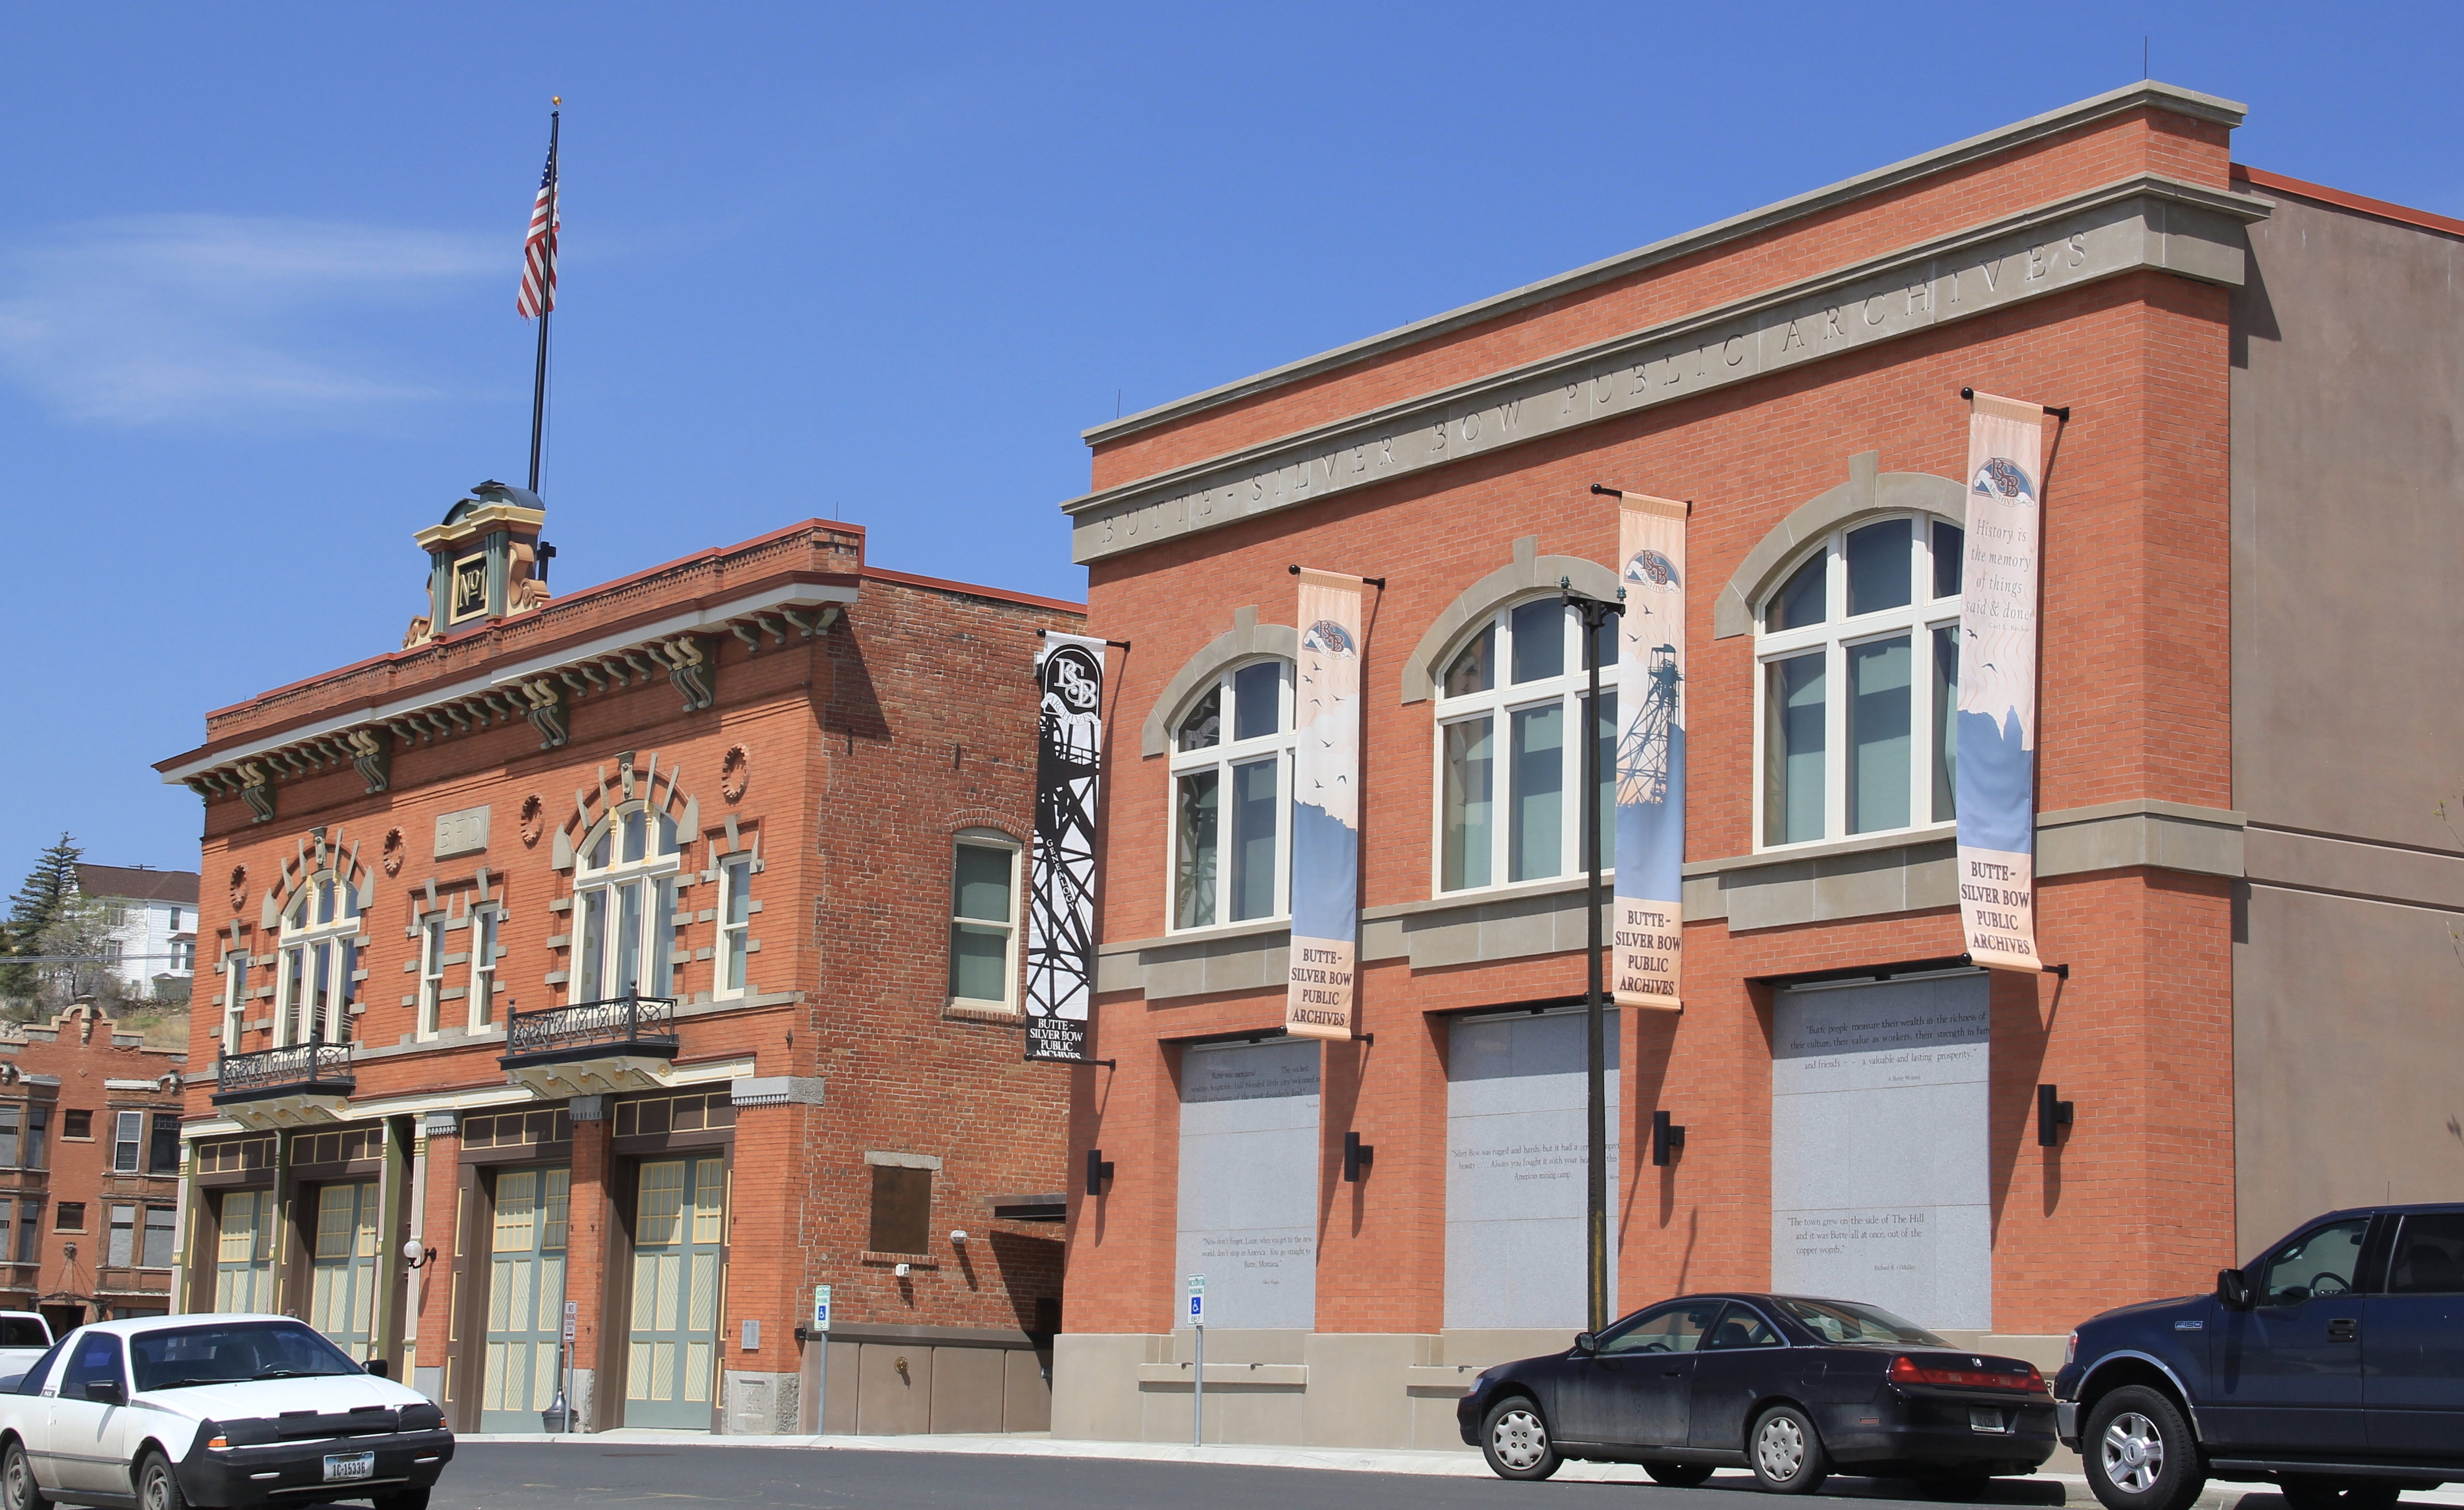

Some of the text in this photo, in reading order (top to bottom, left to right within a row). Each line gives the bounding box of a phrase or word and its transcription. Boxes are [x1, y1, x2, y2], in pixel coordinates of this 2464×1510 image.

[1431, 397, 1523, 452] BOW
[1563, 334, 1745, 414] PUBLIC
[1781, 230, 2085, 352] ARCHIVES
[1987, 484, 2021, 506] ARCHIVES
[1976, 519, 2027, 544] History is
[1971, 545, 2031, 572] the memory
[1976, 572, 2022, 597] of things
[1966, 599, 2032, 621] said & done.
[2010, 625, 2030, 633] Becker
[1048, 696, 1092, 723] ARCHIVES
[1046, 839, 1074, 910] GENEALOGY
[1961, 884, 2030, 908] SILVER BOW
[1976, 910, 2018, 930] PUBLIC
[1615, 931, 1681, 951] SILVER BOW
[1973, 931, 2030, 955] ARCHIVES
[1628, 955, 1669, 972] PUBLIC
[1292, 968, 1352, 986] SILVER BOW
[1620, 975, 1674, 995] ARCHIVES
[1302, 989, 1339, 1005] PUBLIC
[1293, 1007, 1345, 1025] ARCHIVES
[1829, 1022, 1848, 1035] people
[1851, 1022, 1880, 1031] measure
[1882, 1019, 1899, 1028] their
[1901, 1016, 1924, 1026] wealth
[1937, 1015, 1948, 1023] the
[1950, 1013, 1976, 1022] richness
[1979, 1010, 1986, 1020] of
[1030, 1028, 1083, 1041] SILVER BOW
[1791, 1041, 1805, 1049] their
[1807, 1039, 1831, 1048] culture,
[1834, 1037, 1848, 1046] their
[1851, 1035, 1869, 1044] value
[1882, 1032, 1911, 1042] workers,
[1916, 1031, 1933, 1039] their
[1937, 1028, 1965, 1039] strength
[1976, 1025, 1989, 1034] fam
[1041, 1040, 1073, 1051] PUBLIC
[1804, 1060, 1815, 1069] and
[1818, 1058, 1840, 1068] friends
[1869, 1054, 1894, 1065] valuable
[1896, 1053, 1908, 1062] and
[1911, 1053, 1932, 1062] lasting
[1493, 1147, 1509, 1156] rugged
[1459, 1162, 1476, 1170] beauty
[1523, 1158, 1541, 1167] fought
[1564, 1158, 1577, 1166] your
[1514, 1172, 1537, 1180] American
[1823, 1218, 1838, 1226] grew
[1850, 1216, 1862, 1224] the
[1865, 1215, 1879, 1224] side
[1881, 1214, 1889, 1224] of
[1892, 1215, 1906, 1223] The
[1910, 1214, 1924, 1223] Hill
[1796, 1231, 1808, 1239] and
[1831, 1231, 1848, 1239] Butte
[1850, 1229, 1859, 1238] all
[1901, 1228, 1908, 1237] of
[1911, 1228, 1921, 1237] the
[1230, 1250, 1239, 1258] stop
[1288, 1247, 1304, 1255] straight
[1796, 1247, 1817, 1256] copper
